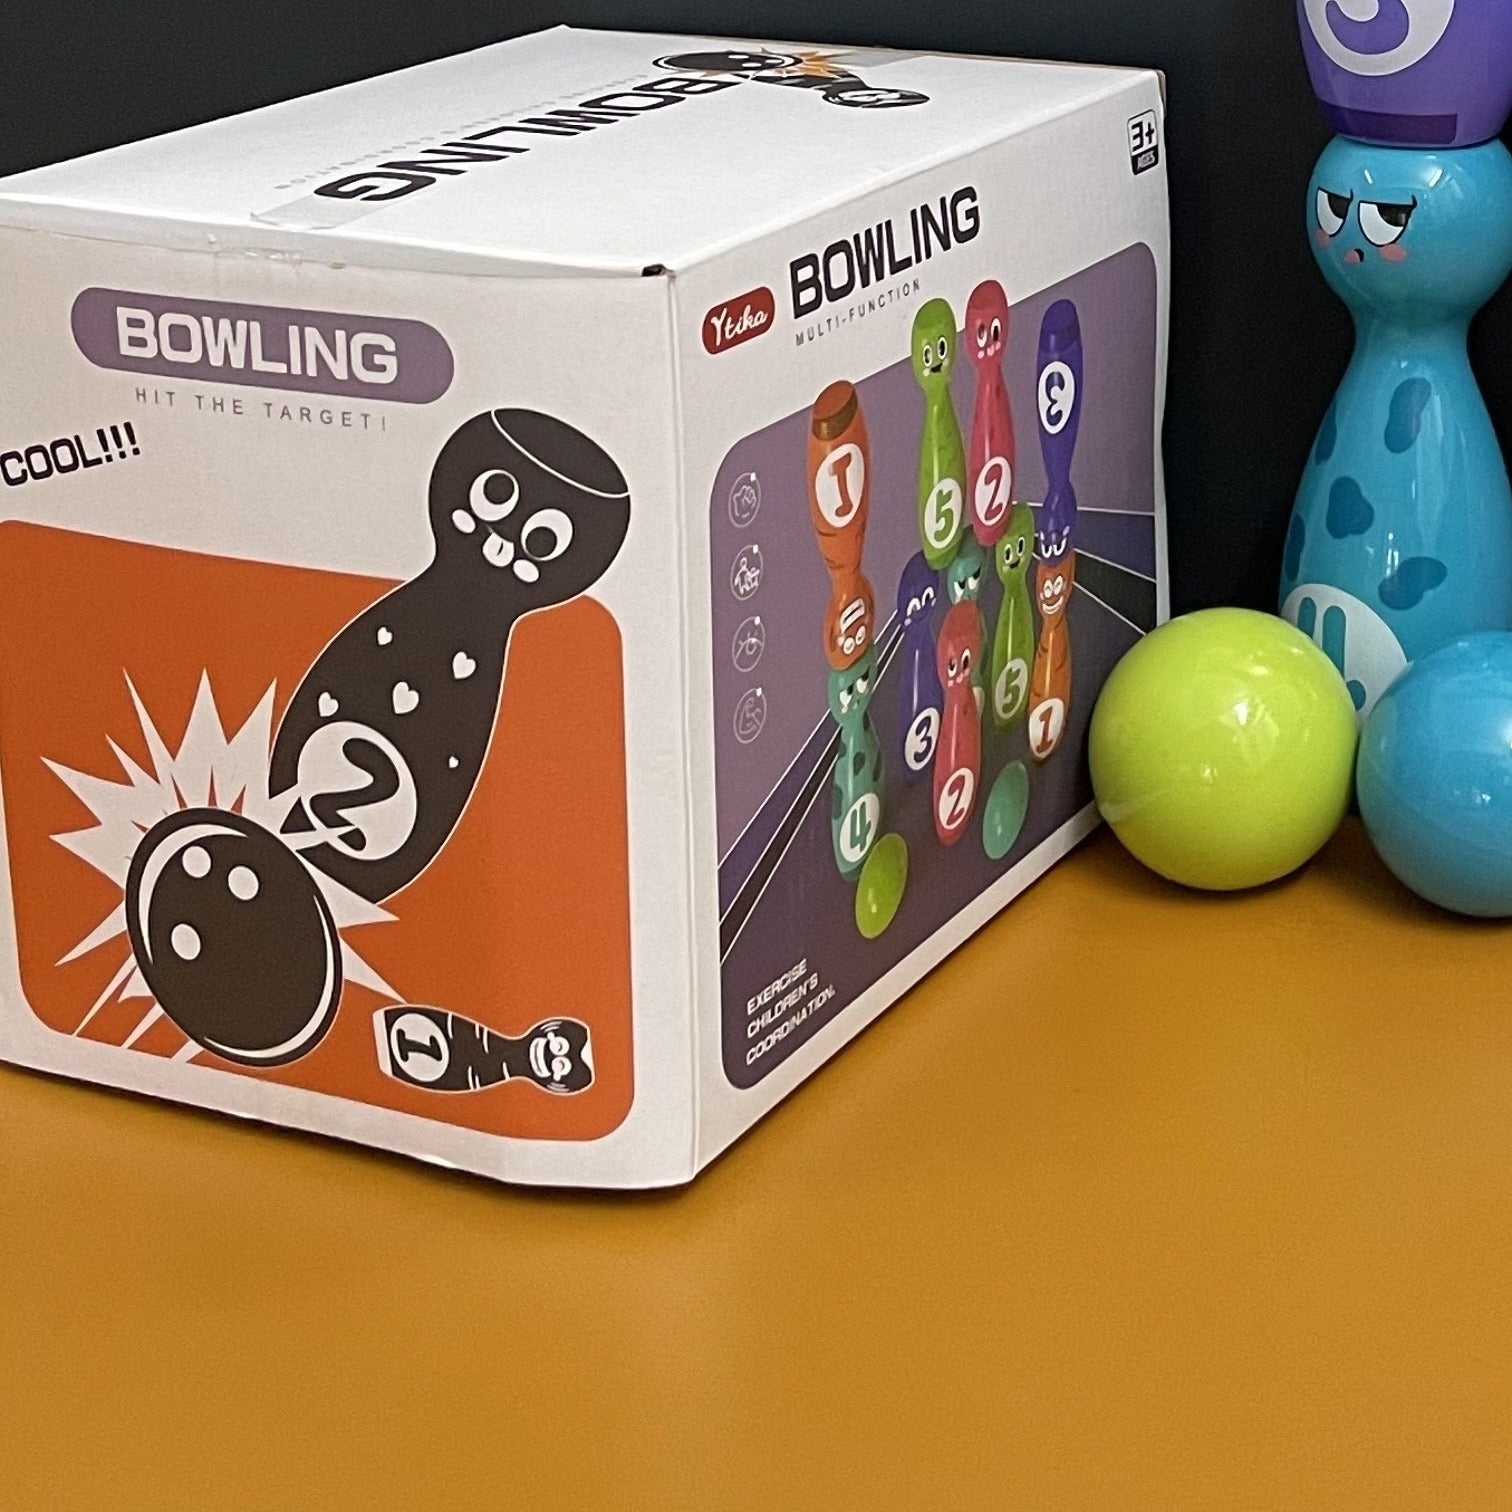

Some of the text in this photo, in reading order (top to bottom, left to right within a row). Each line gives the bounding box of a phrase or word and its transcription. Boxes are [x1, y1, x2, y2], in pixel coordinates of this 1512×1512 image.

[313, 77, 741, 201] BOWLING
[1131, 121, 1155, 152] 3+
[790, 186, 981, 319] BOWLING
[795, 278, 921, 346] MULTI-FUNCTION
[116, 306, 399, 384] BOWLING
[135, 387, 387, 431] HIT THE TARGET!
[1045, 371, 1065, 427] 3
[0, 421, 140, 487] COOL!!!
[933, 488, 954, 542] 5
[984, 462, 1003, 522] 2
[913, 715, 932, 763] 3
[1036, 705, 1054, 754] 1
[309, 737, 400, 852] 2
[946, 770, 965, 826] 2
[849, 800, 872, 853] 4
[747, 958, 807, 1015] EXERCISE
[747, 972, 818, 1038] CHILDREN'S
[396, 1028, 443, 1062] 1
